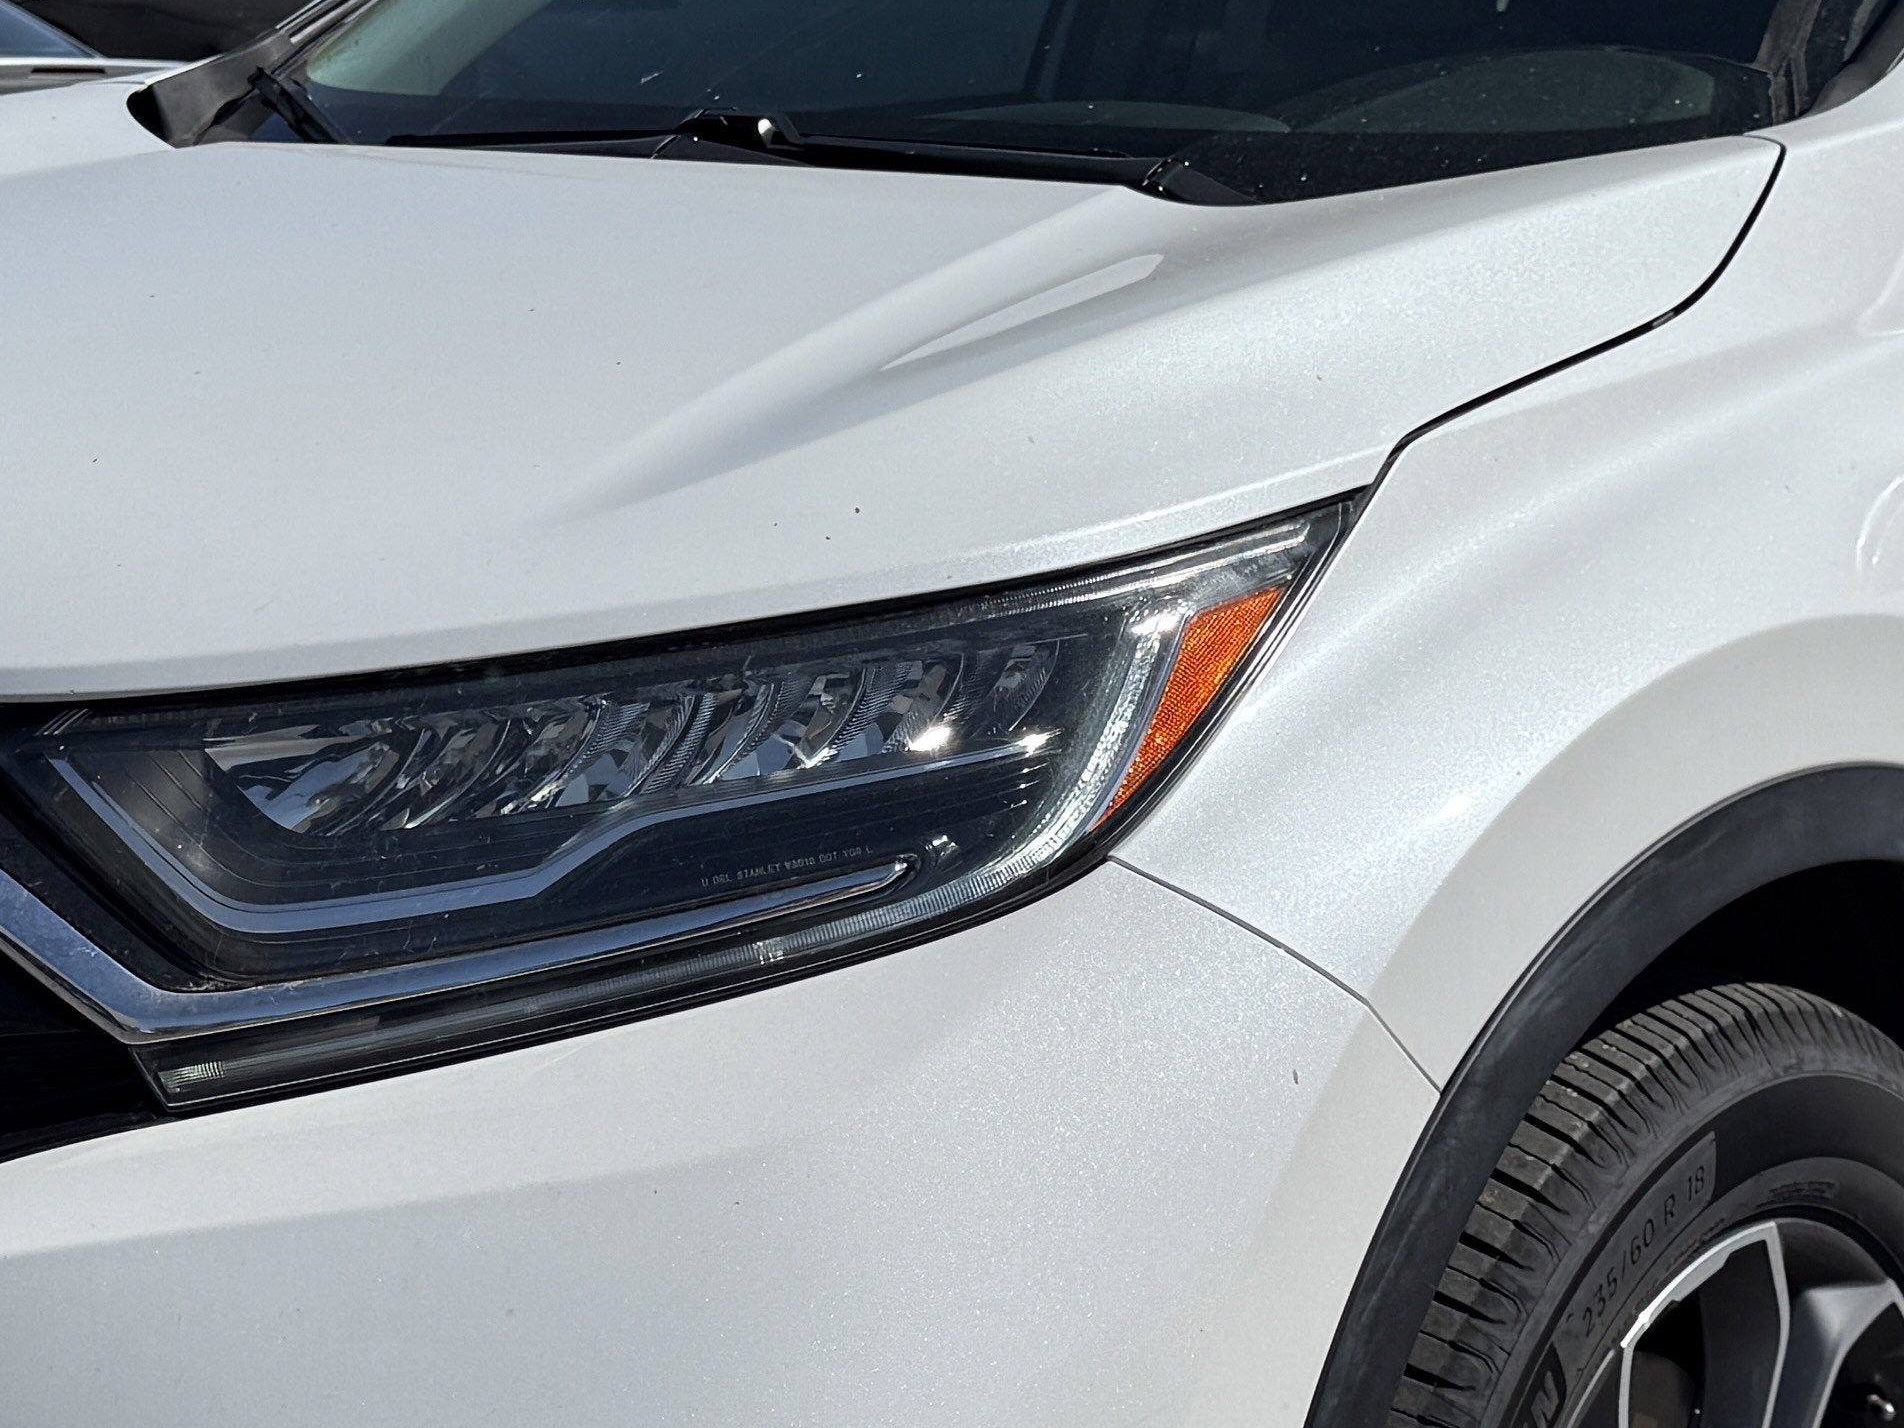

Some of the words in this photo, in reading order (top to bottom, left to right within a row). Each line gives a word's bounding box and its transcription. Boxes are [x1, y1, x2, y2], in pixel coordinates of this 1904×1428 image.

[736, 863, 781, 881] STANLEY
[1581, 1218, 1656, 1338] 235/60
[1663, 1193, 1676, 1226] R
[1687, 1164, 1705, 1202] 18
